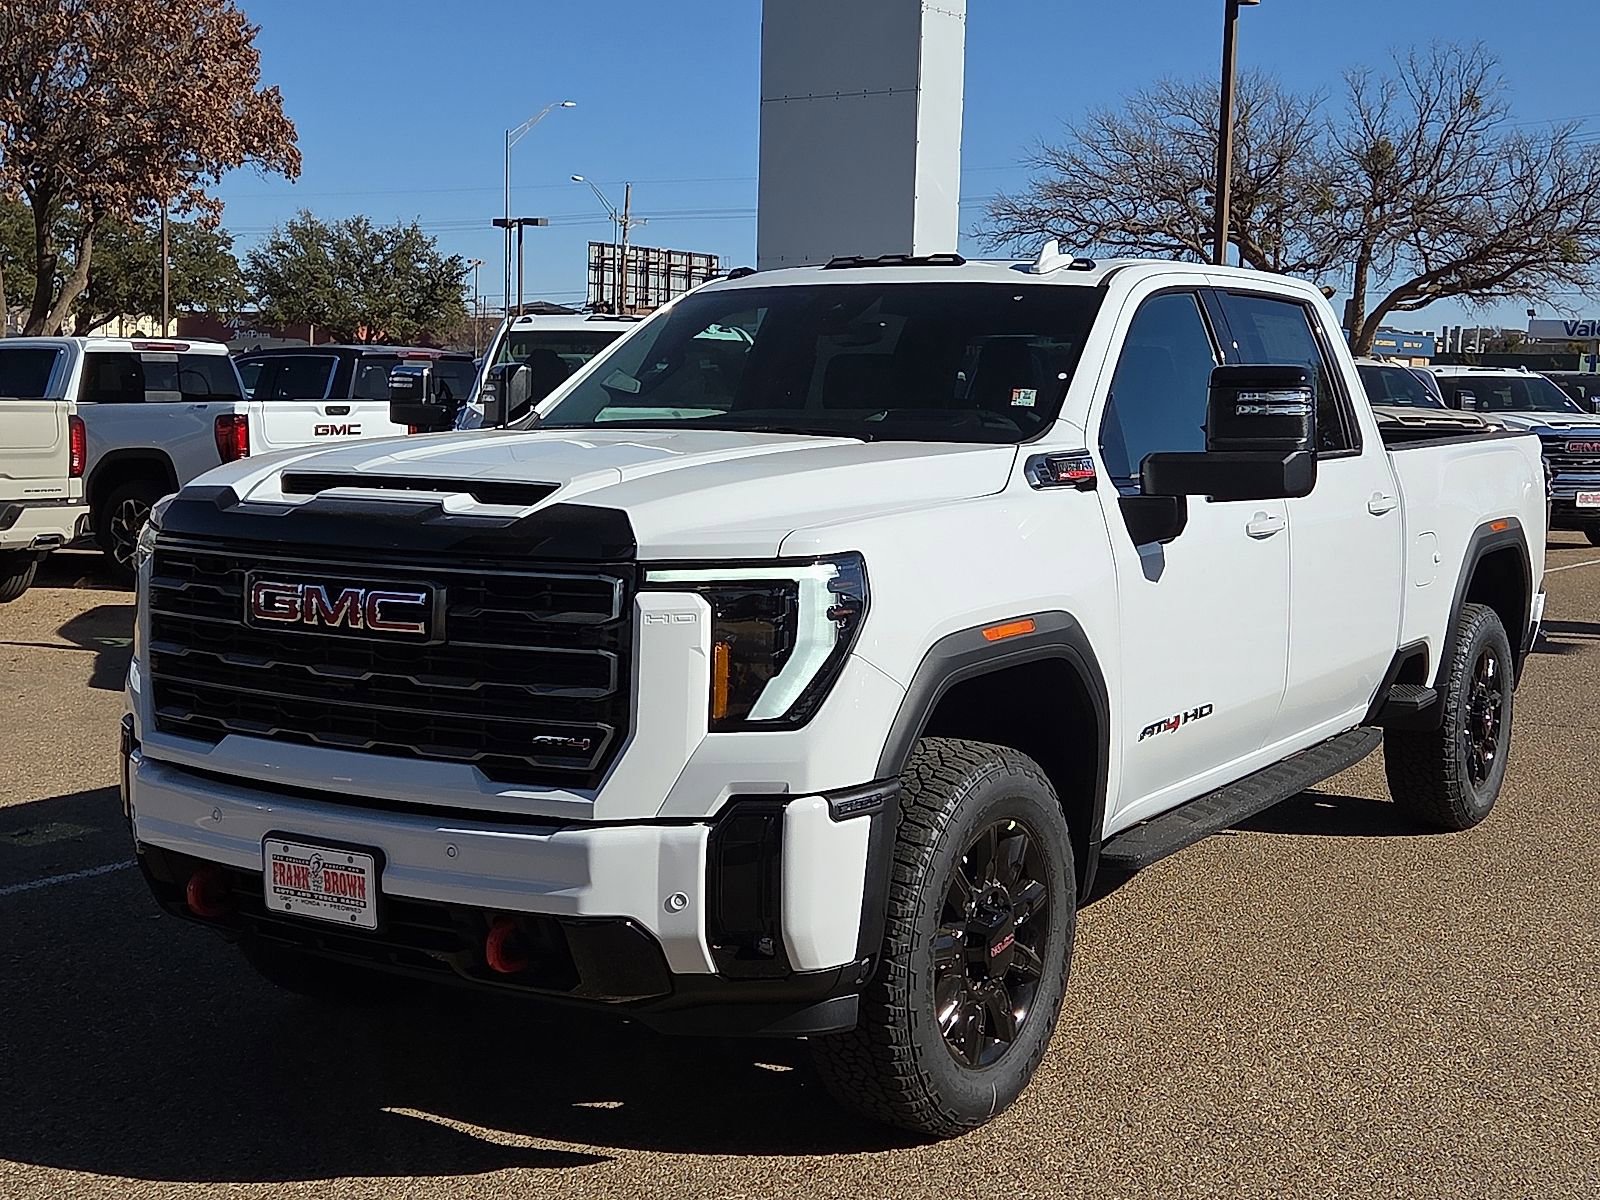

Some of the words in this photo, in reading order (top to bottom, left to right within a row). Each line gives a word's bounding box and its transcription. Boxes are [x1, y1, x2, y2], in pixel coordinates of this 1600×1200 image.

[1563, 320, 1600, 336] Val
[314, 424, 362, 436] GMC
[1570, 443, 1600, 453] GM
[252, 581, 427, 634] GMC
[645, 613, 697, 625] HD
[1138, 714, 1181, 743] AT4
[1182, 703, 1213, 726] HD
[532, 736, 591, 751] AT4
[273, 862, 311, 890] FRANK
[324, 870, 366, 898] BROWN
[275, 887, 295, 896] AUTO
[296, 890, 312, 899] AND
[314, 893, 338, 903] TRUCK
